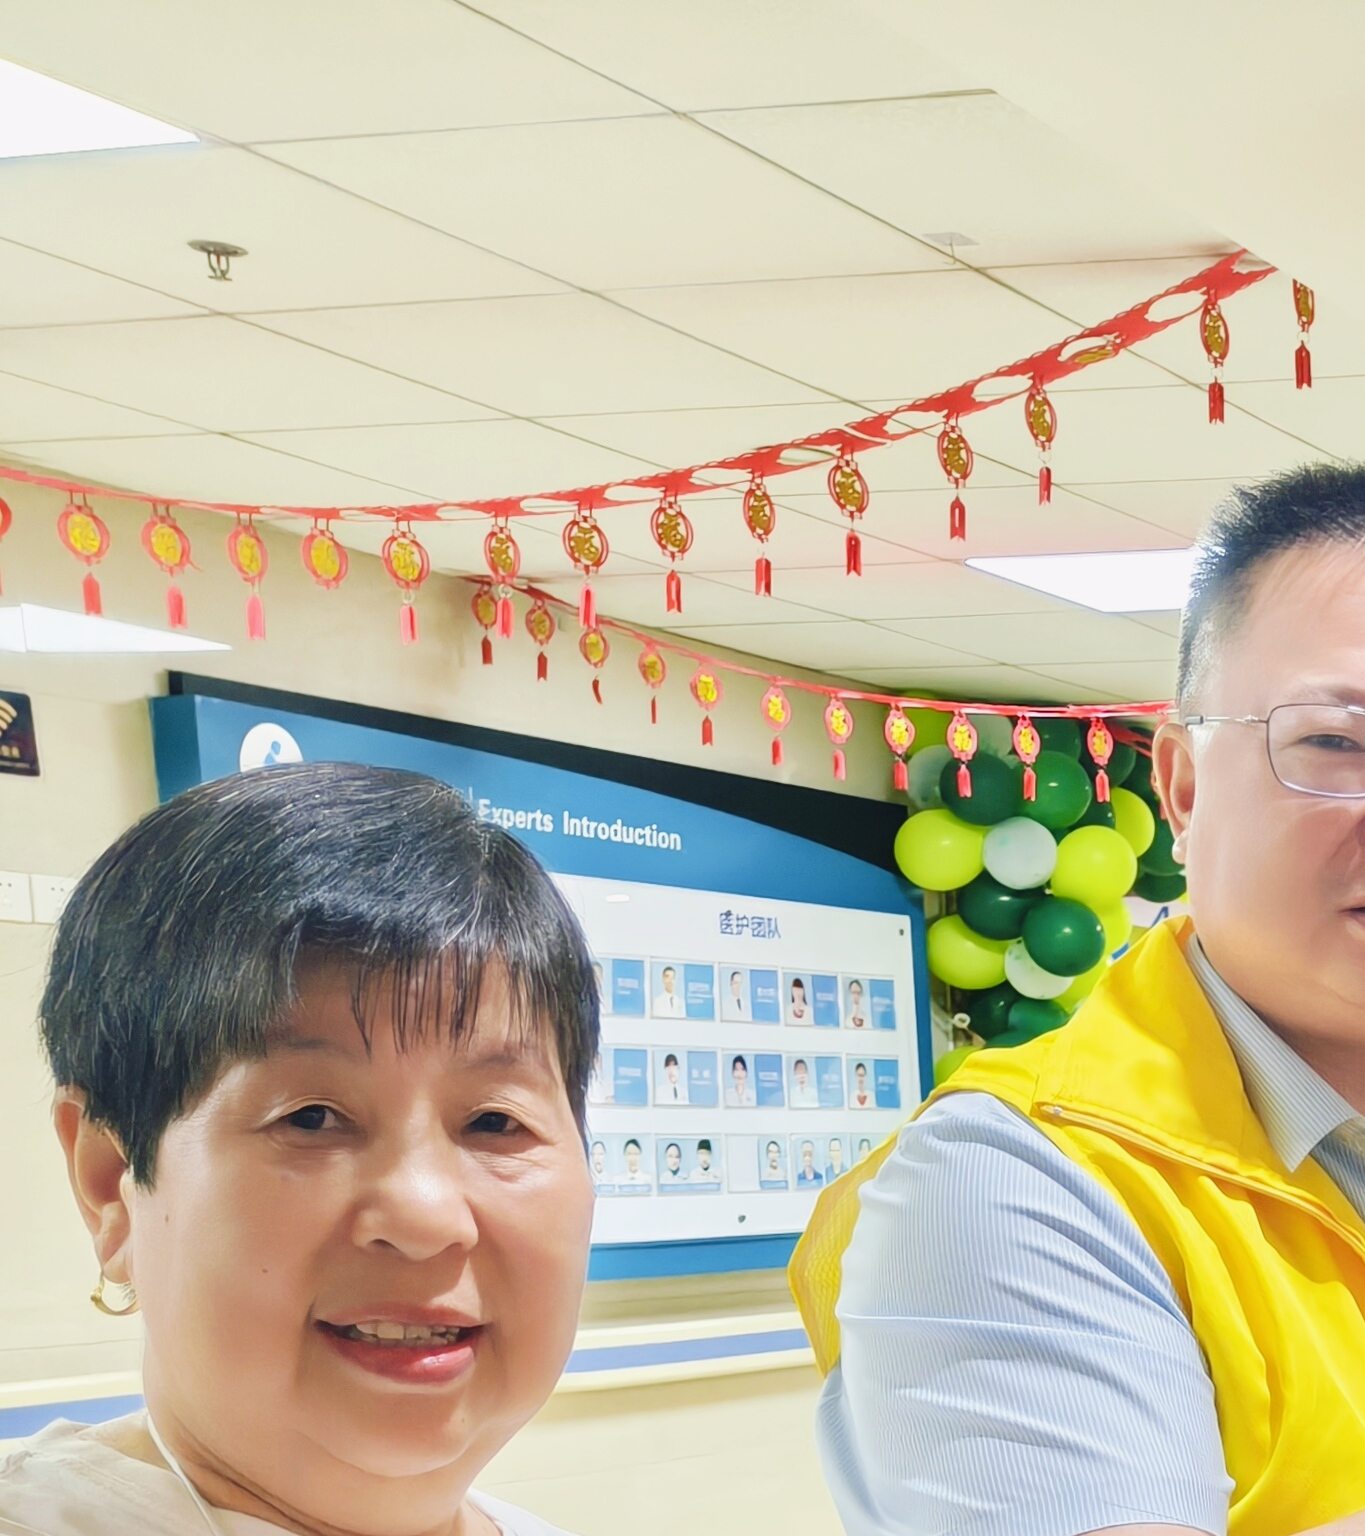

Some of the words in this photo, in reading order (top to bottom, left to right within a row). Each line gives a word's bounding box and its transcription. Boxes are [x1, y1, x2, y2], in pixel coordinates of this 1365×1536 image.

[477, 798, 554, 833] Experts
[563, 811, 682, 851] Introduction
[719, 909, 781, 939] 医护团队
